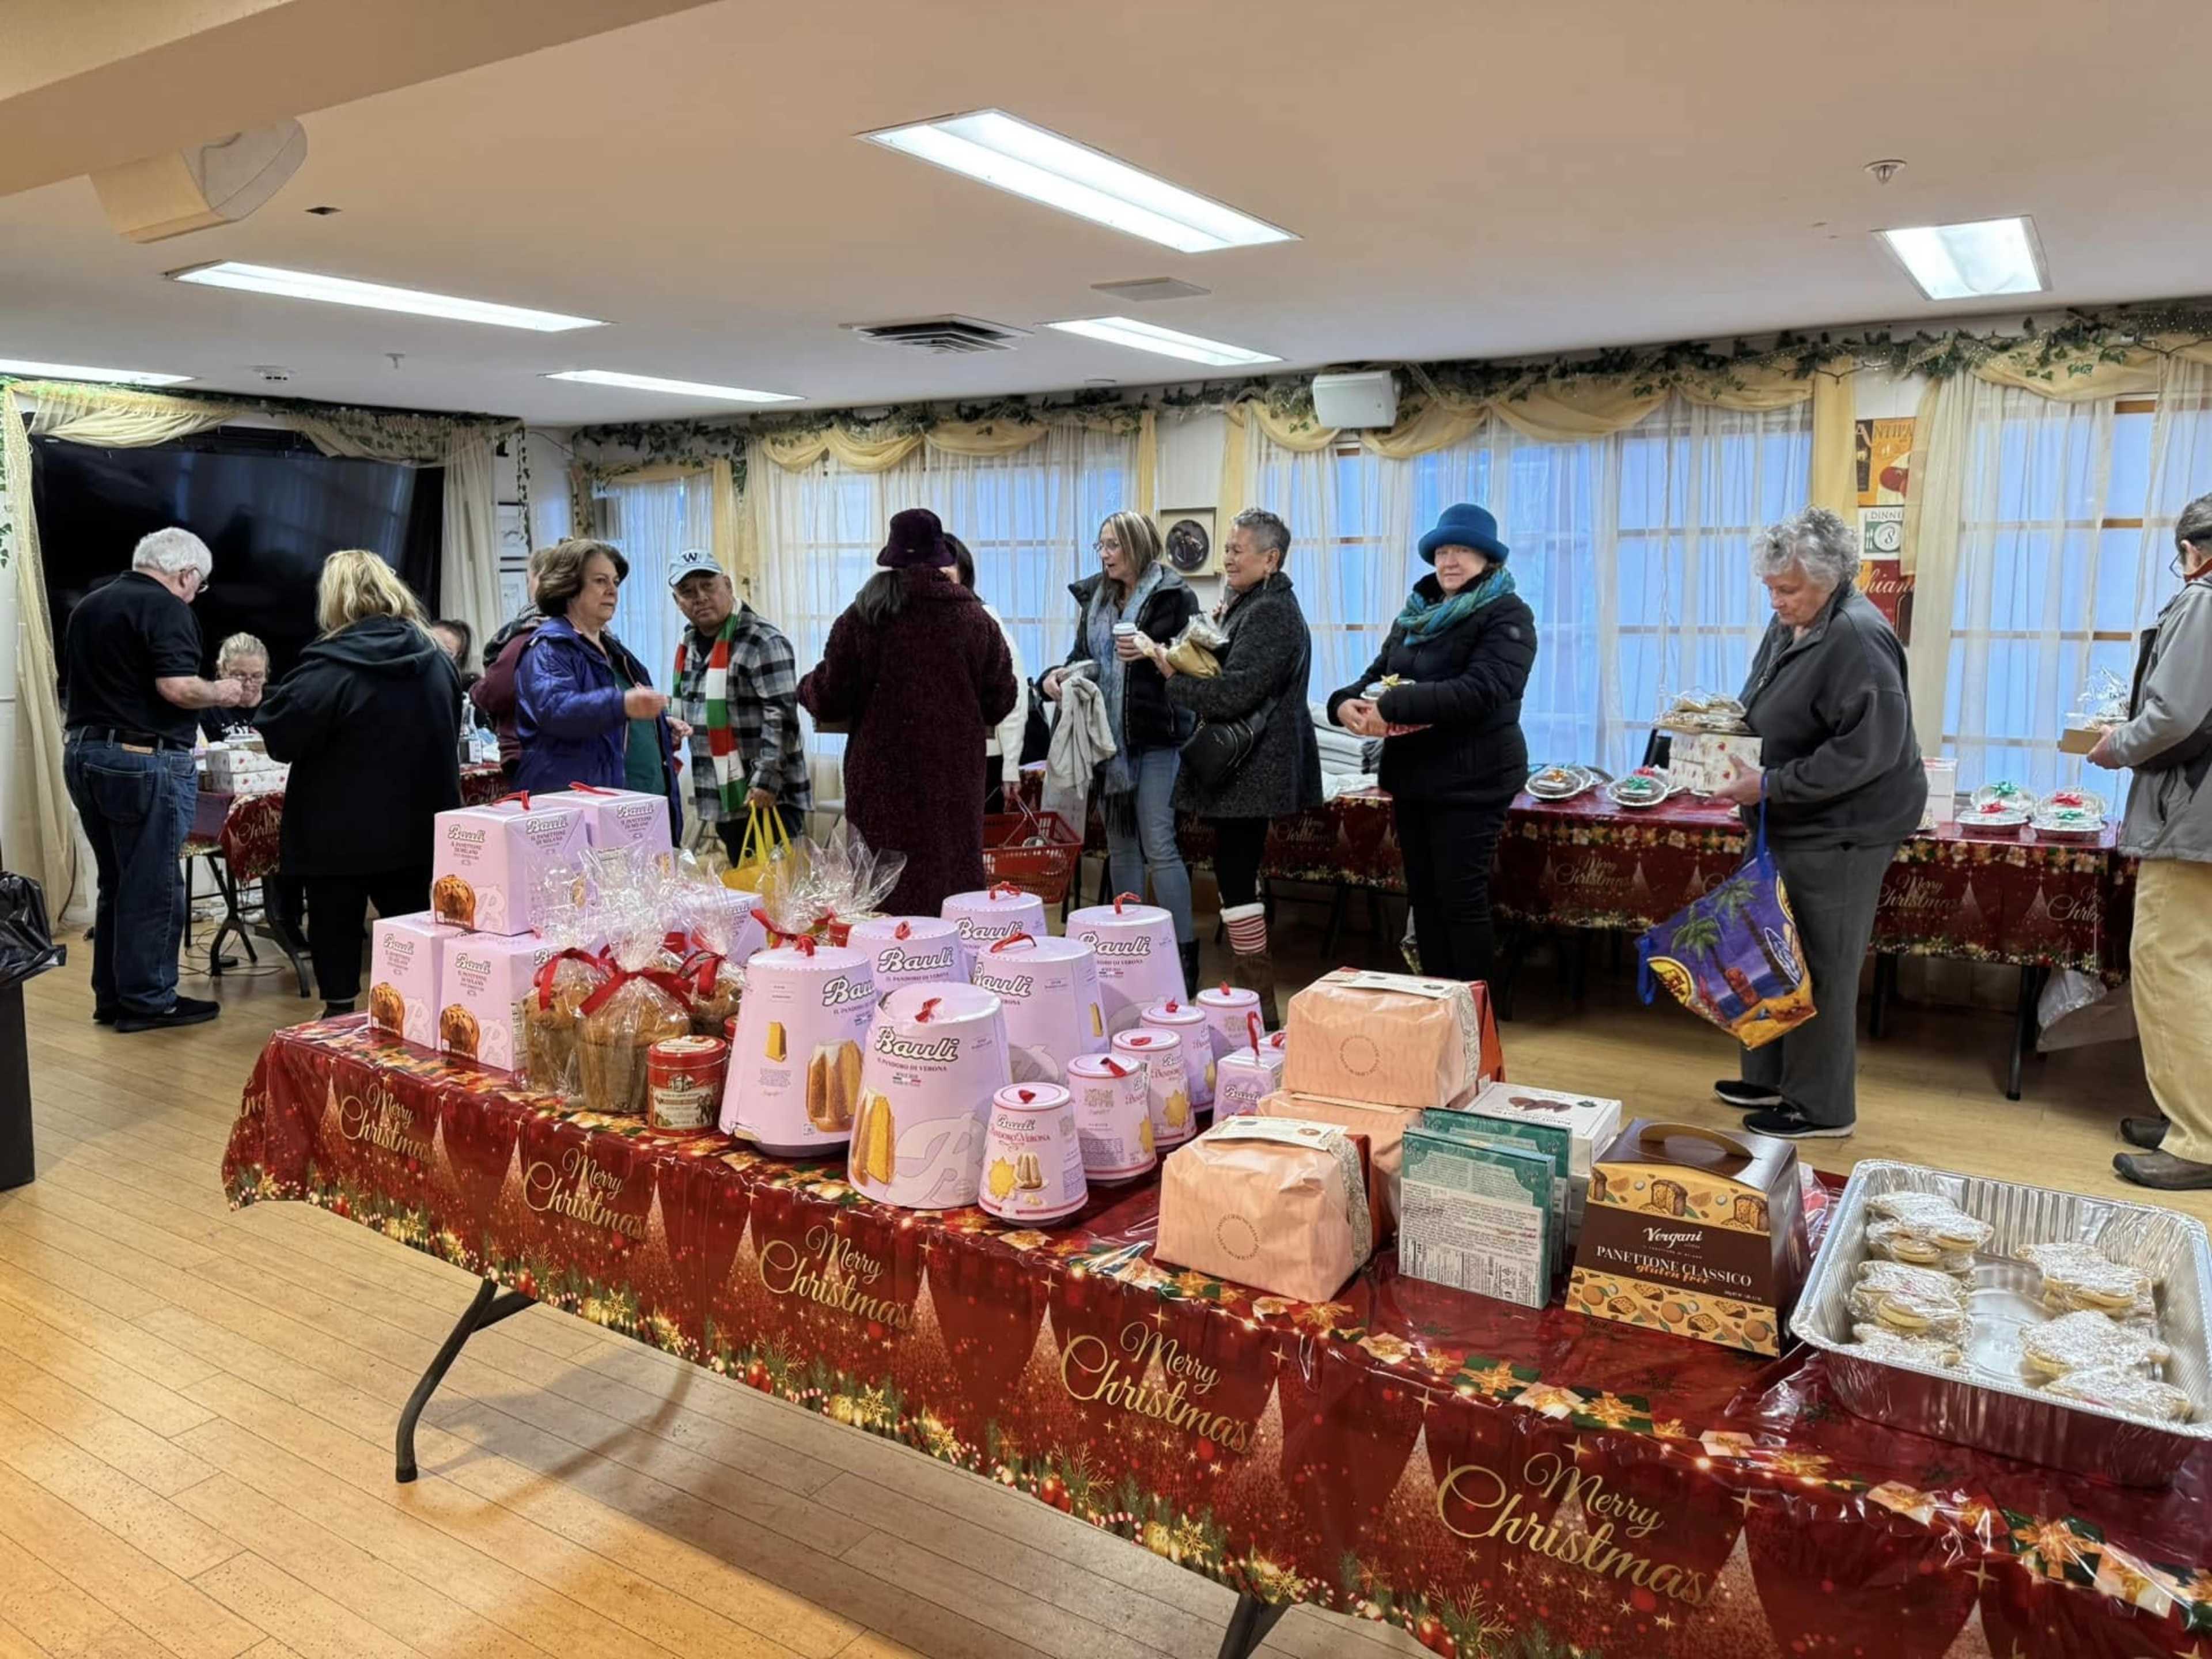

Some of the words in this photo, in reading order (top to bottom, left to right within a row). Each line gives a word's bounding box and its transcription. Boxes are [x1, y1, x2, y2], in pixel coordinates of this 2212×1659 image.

[681, 552, 698, 562] W
[448, 824, 485, 843] Bauli
[526, 815, 569, 834] Bauli
[955, 916, 1024, 941] Bauli
[877, 947, 953, 973] Bauli
[822, 975, 875, 1007] Bau
[874, 1026, 960, 1062] Bauli
[366, 1084, 414, 1129] Merry
[339, 1095, 434, 1163] Christmas
[562, 1148, 623, 1200] Merry
[524, 1157, 646, 1240] Christmas
[806, 1225, 883, 1285] Merry
[1643, 1228, 1703, 1248] Vergani
[760, 1234, 912, 1330] Christmas
[1597, 1245, 1679, 1271] PANETTONE
[1682, 1263, 1752, 1287] CLASSICO
[1635, 1264, 1682, 1279] gluten
[1683, 1271, 1710, 1285] free
[1120, 1321, 1221, 1395] Merry
[1061, 1327, 1251, 1453] Christmas
[1524, 1452, 1665, 1539] Merry
[1438, 1453, 1713, 1607] Christmas
